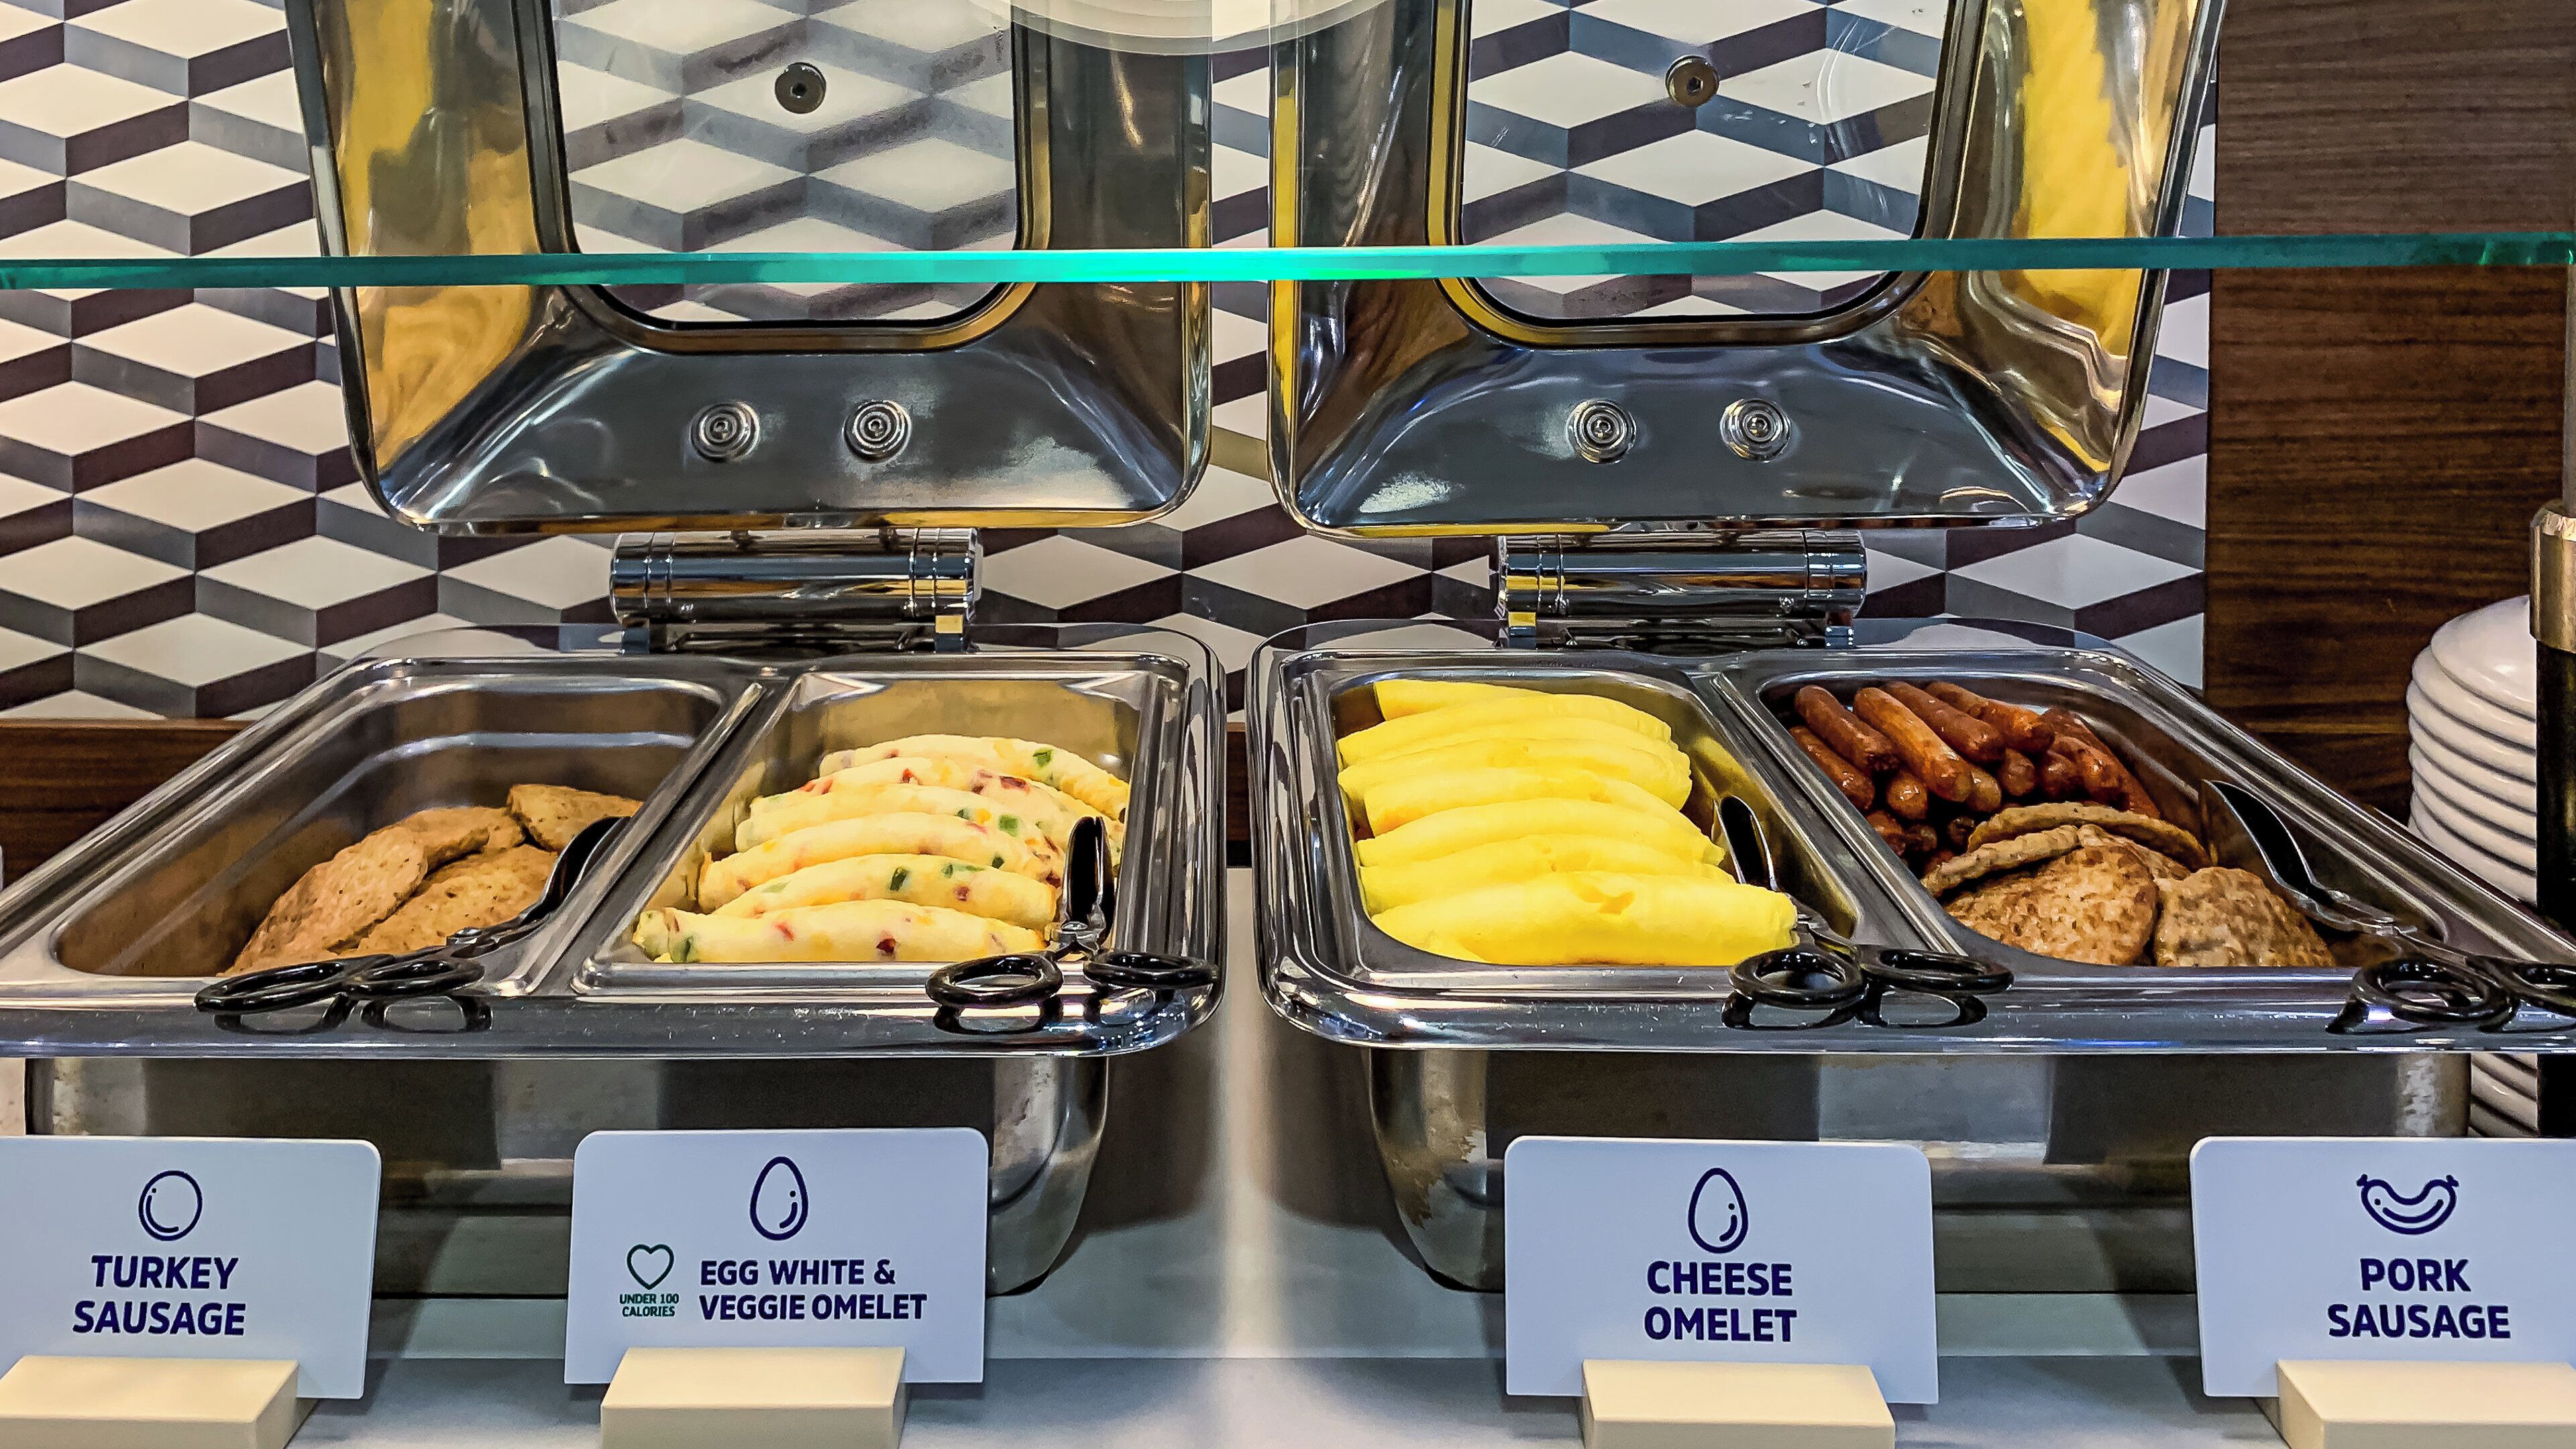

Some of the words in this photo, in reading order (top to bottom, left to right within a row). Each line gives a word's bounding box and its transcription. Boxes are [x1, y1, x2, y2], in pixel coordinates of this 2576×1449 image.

[90, 1254, 239, 1290] TURKEY
[700, 1259, 759, 1286] EGG
[768, 1258, 865, 1286] WHITE
[873, 1258, 896, 1285] &
[1647, 1260, 1794, 1297] CHEESE
[2359, 1257, 2472, 1292] PORK
[619, 1293, 657, 1305] UNDER
[659, 1293, 680, 1305] 100
[622, 1305, 676, 1318] CALORIES
[699, 1293, 806, 1320] VEGGIE
[811, 1293, 928, 1320] OMELET
[72, 1300, 246, 1336] SAUSAGE
[1644, 1305, 1798, 1342] OMELET
[2327, 1303, 2511, 1340] SAUSAGE
